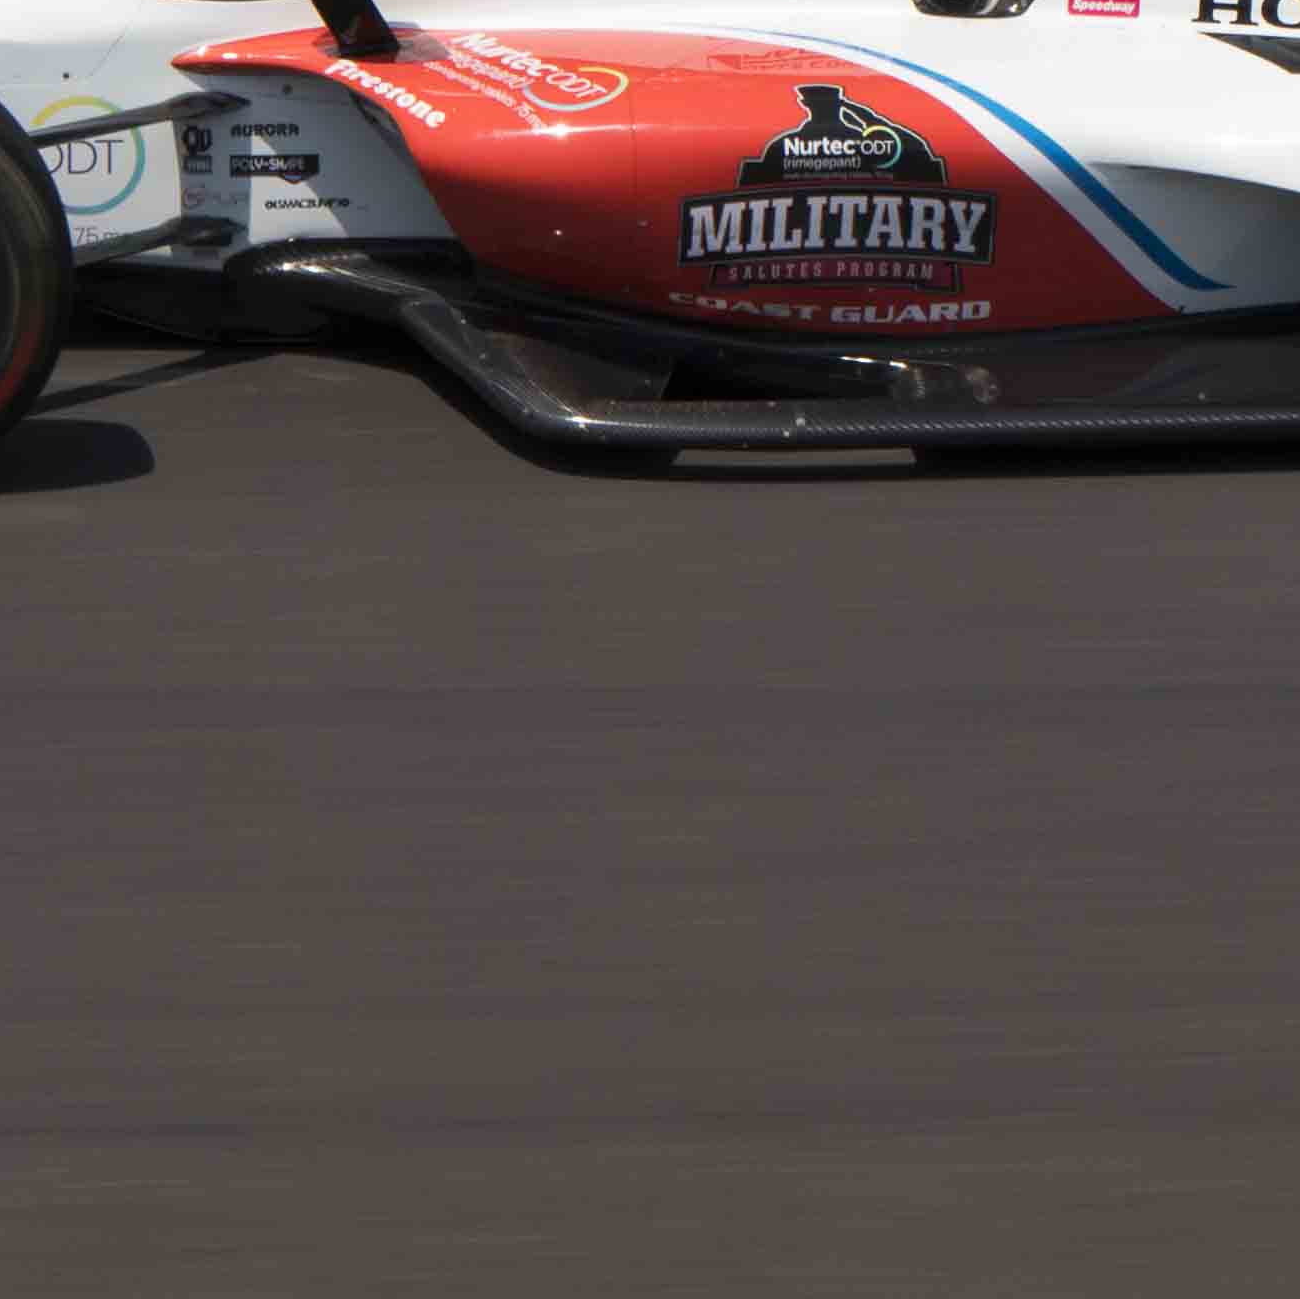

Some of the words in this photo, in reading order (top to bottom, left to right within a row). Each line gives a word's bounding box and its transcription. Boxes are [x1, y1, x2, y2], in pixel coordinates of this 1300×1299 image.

[324, 58, 447, 129] Firestone
[230, 123, 300, 137] AURORA
[783, 136, 856, 156] Nurtec
[860, 139, 895, 156] ODT
[686, 195, 987, 259] MILITARY
[728, 260, 822, 280] SALUTES
[836, 260, 934, 279] PROGRAM
[668, 290, 822, 320] COAST
[830, 300, 992, 324] GUARD
